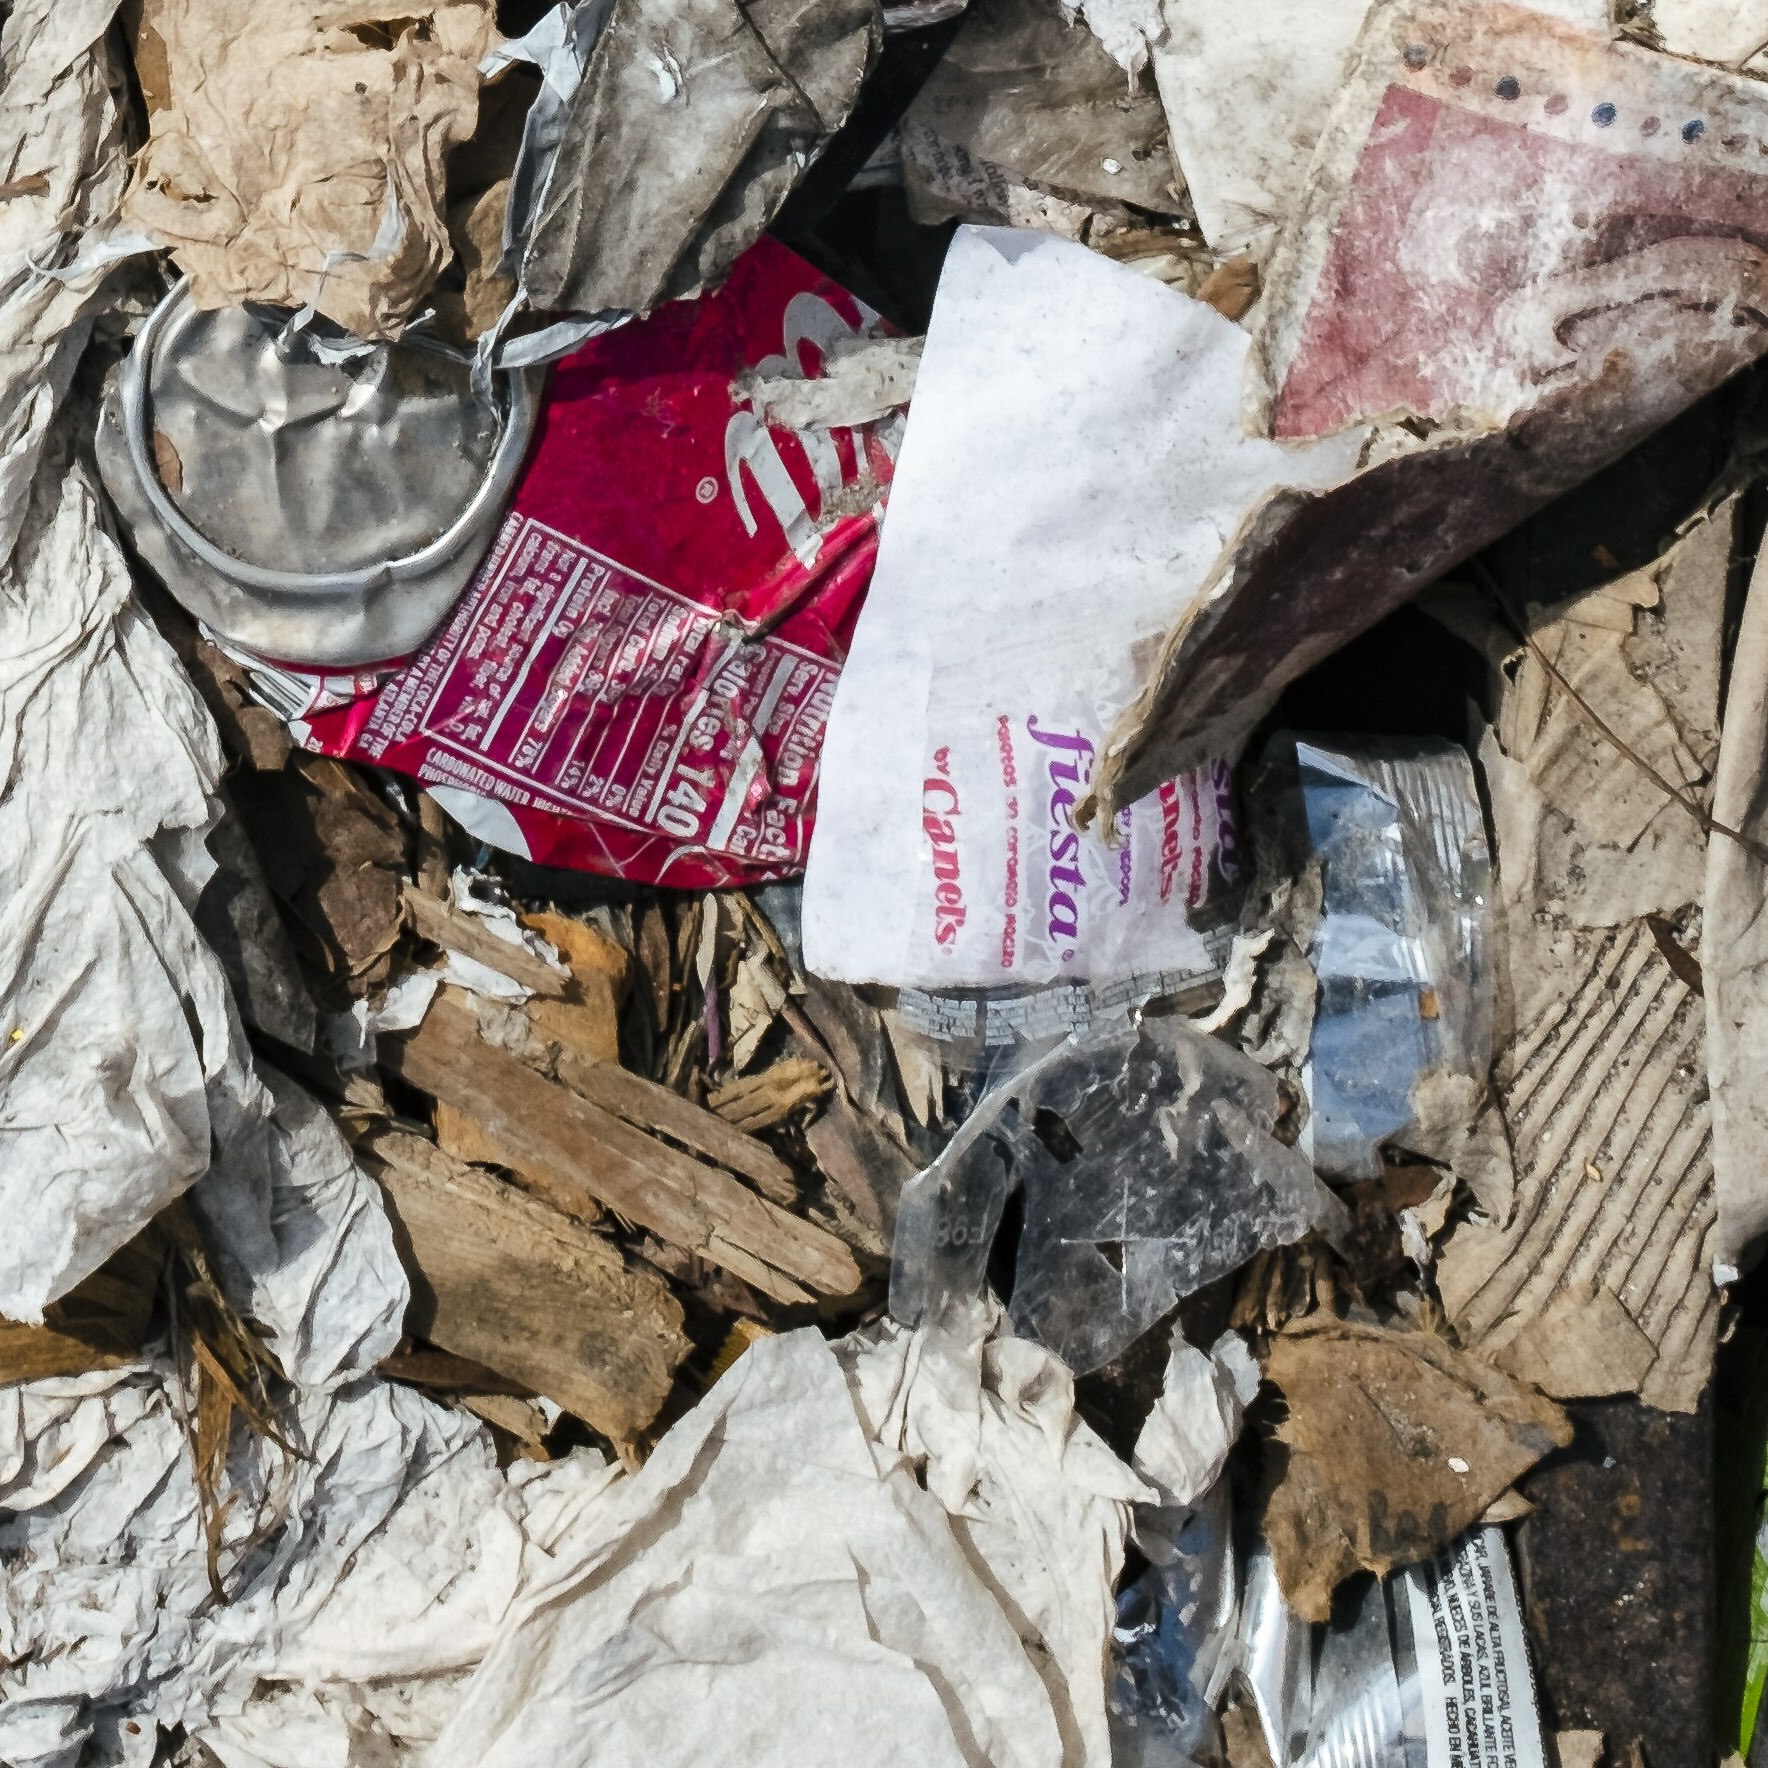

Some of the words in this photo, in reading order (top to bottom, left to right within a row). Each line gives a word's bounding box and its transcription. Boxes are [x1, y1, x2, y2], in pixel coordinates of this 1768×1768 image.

[393, 681, 434, 745] COCA-COLA
[691, 634, 754, 754] Calories
[773, 669, 839, 789] Nutrition
[422, 746, 498, 791] CARBONATED
[492, 779, 532, 806] WATER
[558, 756, 586, 792] 14%
[625, 776, 654, 819] Value
[655, 757, 721, 840] 140
[1025, 712, 1110, 943] fiesta
[920, 776, 969, 946] Canel's
[1467, 1599, 1483, 1623] SUS
[1476, 1664, 1492, 1689] AZUL
[1488, 1621, 1502, 1649] ALTA
[1499, 1714, 1515, 1752] ACEITE
[1443, 1695, 1461, 1735] HECHO
[1478, 1694, 1498, 1752] BRILLANTE
